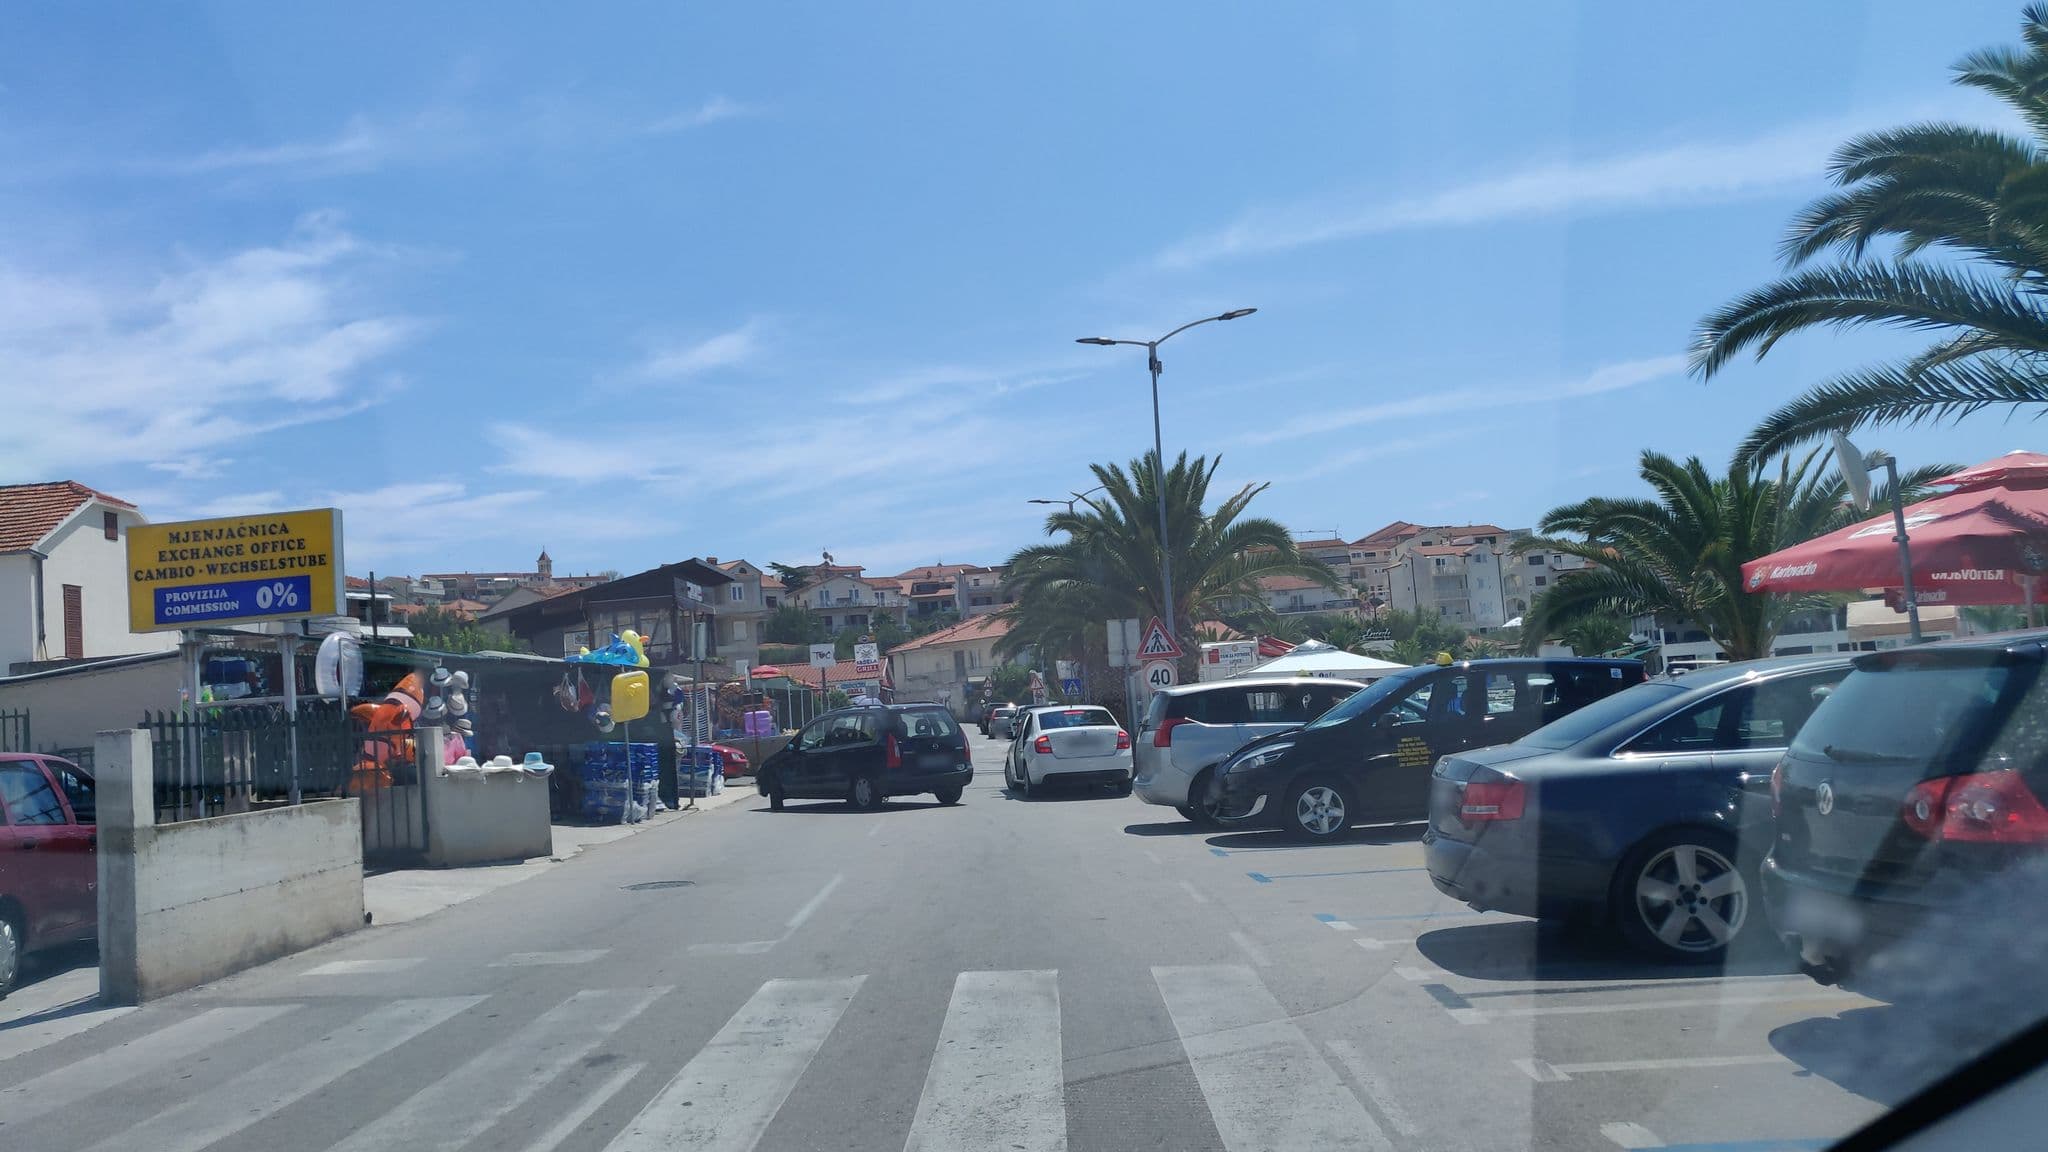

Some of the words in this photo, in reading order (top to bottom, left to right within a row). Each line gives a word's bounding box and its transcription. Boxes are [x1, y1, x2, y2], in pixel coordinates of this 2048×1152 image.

[168, 522, 289, 543] MJENJAČNICA
[158, 544, 246, 562] EXCHANGE
[250, 538, 306, 555] OFFICE
[133, 563, 196, 582] CAMBIO
[206, 553, 328, 576] WECHSELSTUBE
[164, 588, 229, 604] PROVIZIJA
[255, 581, 299, 610] 0%
[164, 600, 240, 617] COMMISSION
[1150, 668, 1171, 686] 40
